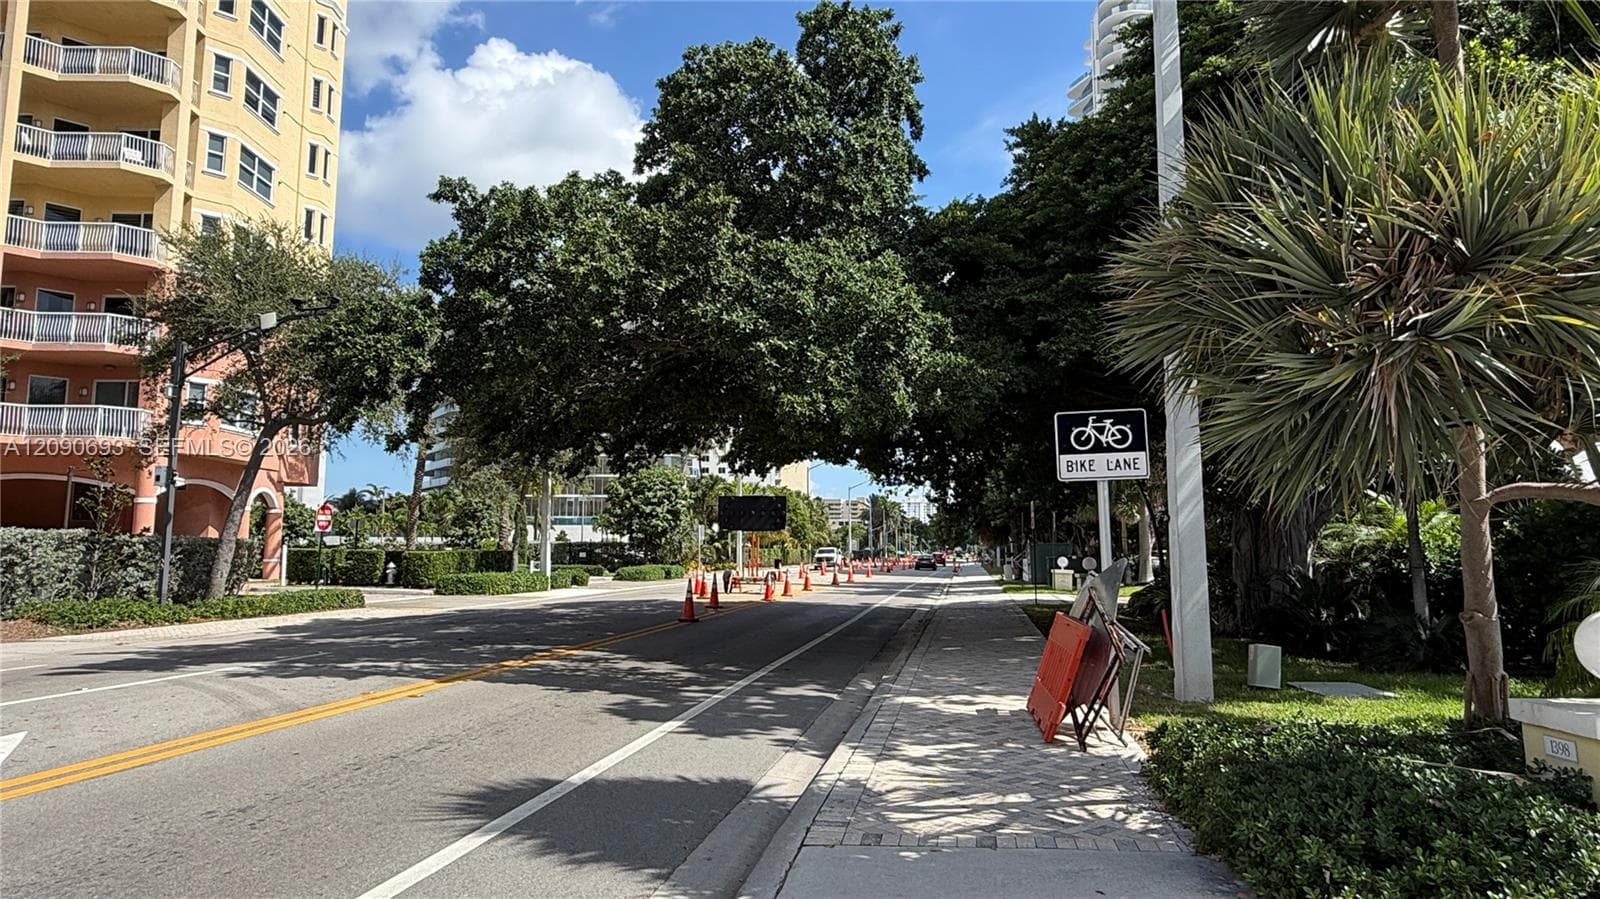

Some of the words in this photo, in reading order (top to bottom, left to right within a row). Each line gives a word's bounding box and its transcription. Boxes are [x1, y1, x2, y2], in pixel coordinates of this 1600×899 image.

[1066, 459, 1096, 473] BIKE
[1106, 457, 1141, 472] LANE
[1550, 739, 1571, 758] 1398
